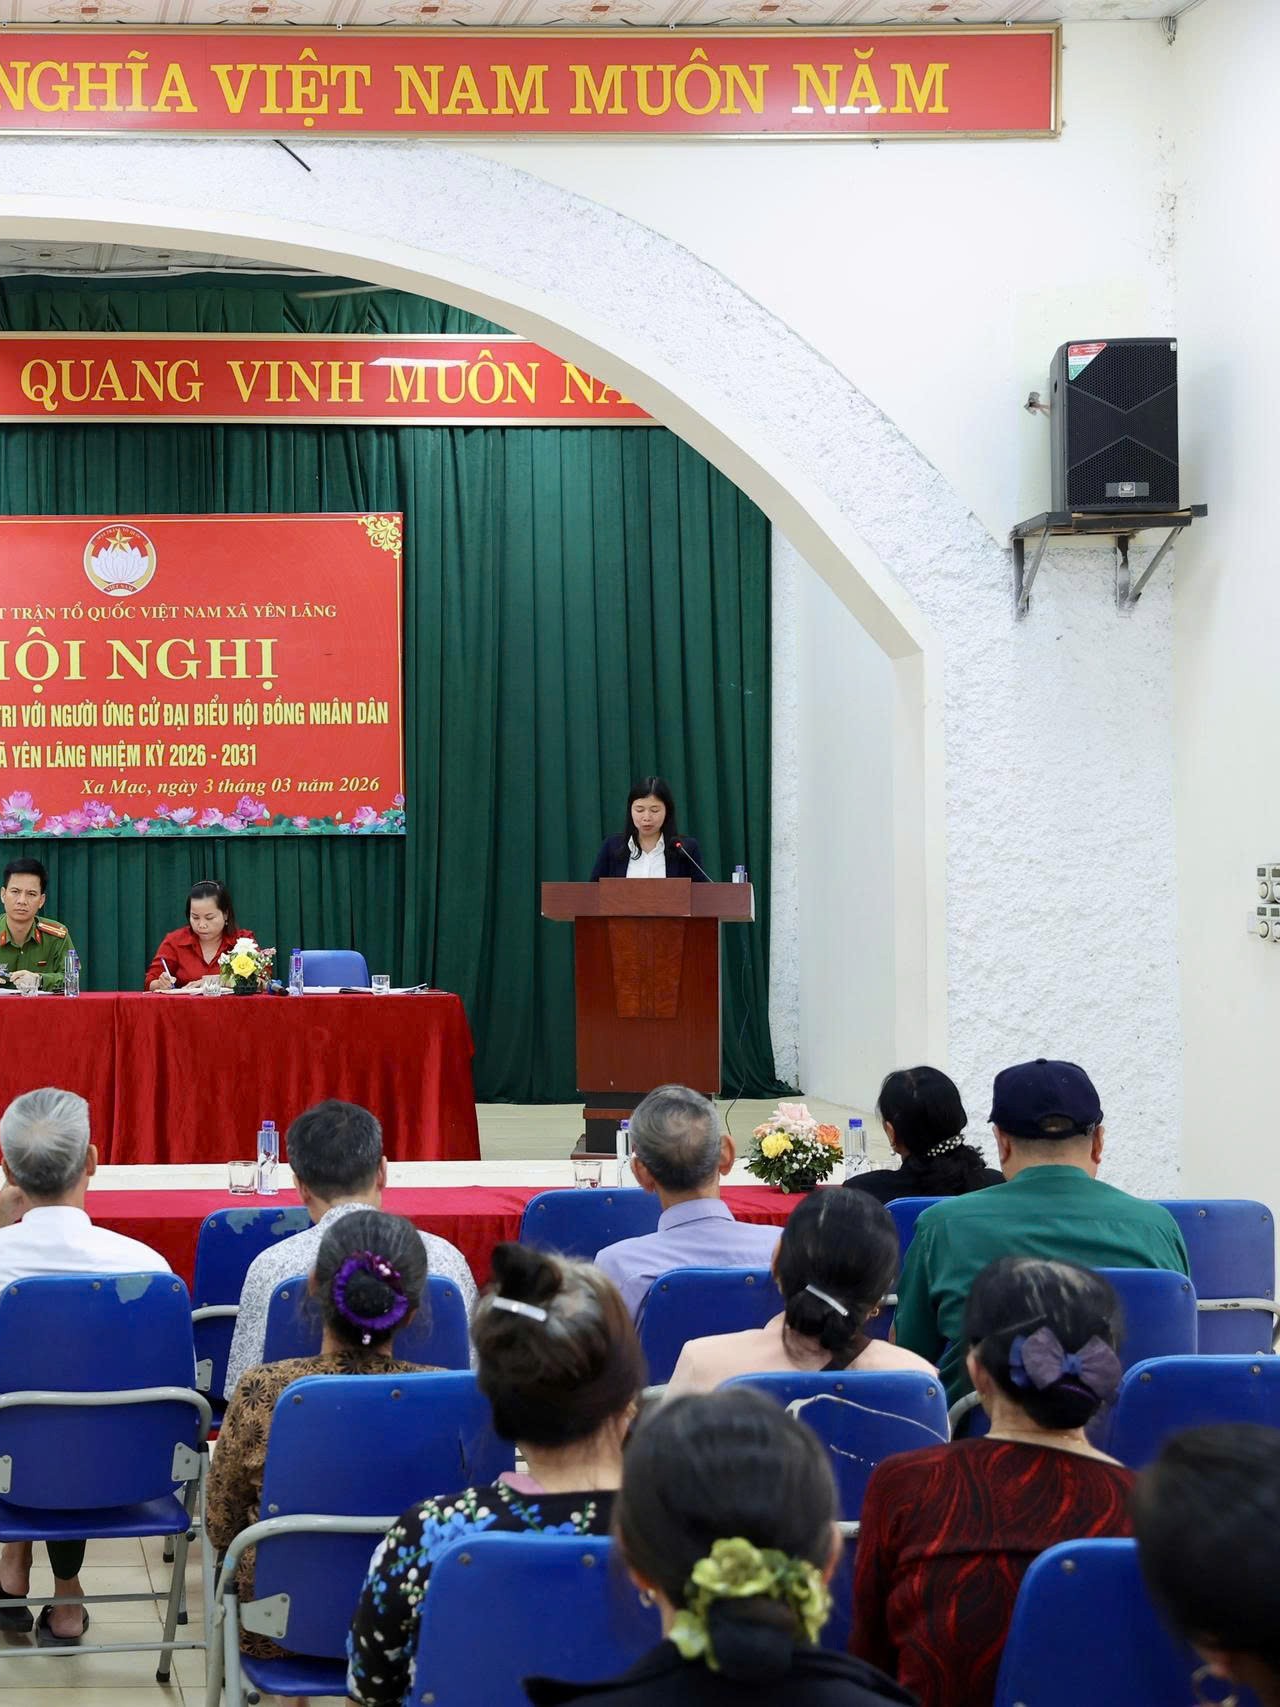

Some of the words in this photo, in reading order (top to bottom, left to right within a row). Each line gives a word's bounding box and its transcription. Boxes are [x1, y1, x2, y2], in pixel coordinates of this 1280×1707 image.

[210, 48, 371, 127] VIỆT
[394, 65, 550, 115] NAM
[569, 48, 769, 116] MUÔN
[792, 47, 950, 114] NĂM
[20, 359, 204, 412] QUANG
[226, 360, 365, 403] VINH
[385, 349, 540, 404] MUÔN
[11, 604, 56, 622] TRẬN
[60, 601, 84, 620] TỔ
[88, 601, 136, 621] QUỐC
[140, 603, 180, 622] VIỆT
[184, 606, 221, 618] NAM
[226, 603, 248, 618] XÃ
[254, 602, 286, 618] YÊN
[291, 603, 337, 618] LÃNG
[106, 638, 279, 690] NGHỊ
[21, 700, 46, 728] VỚI
[51, 699, 98, 727] NGƯỜI
[102, 698, 134, 727] ỨNG
[138, 696, 161, 726] CỬ
[163, 703, 189, 731] ĐẠI
[194, 694, 228, 726] BIỂU
[233, 698, 259, 731] HỘI
[263, 695, 305, 725] ĐỒNG
[310, 697, 352, 725] NHÂN
[357, 697, 389, 725] DÂN
[12, 741, 42, 769] YÊN
[47, 741, 86, 768] LÃNG
[91, 740, 141, 772] NHIỆM
[145, 739, 165, 767] KỲ
[170, 744, 207, 767] 2026
[222, 743, 257, 767] 2031
[81, 779, 105, 794] Xa
[109, 779, 152, 797] Mạc,
[157, 780, 198, 797] ngày
[204, 778, 214, 794] 3
[218, 778, 267, 797] tháng
[272, 777, 292, 793] 03
[297, 778, 334, 792] năm
[339, 777, 380, 792] 2026
